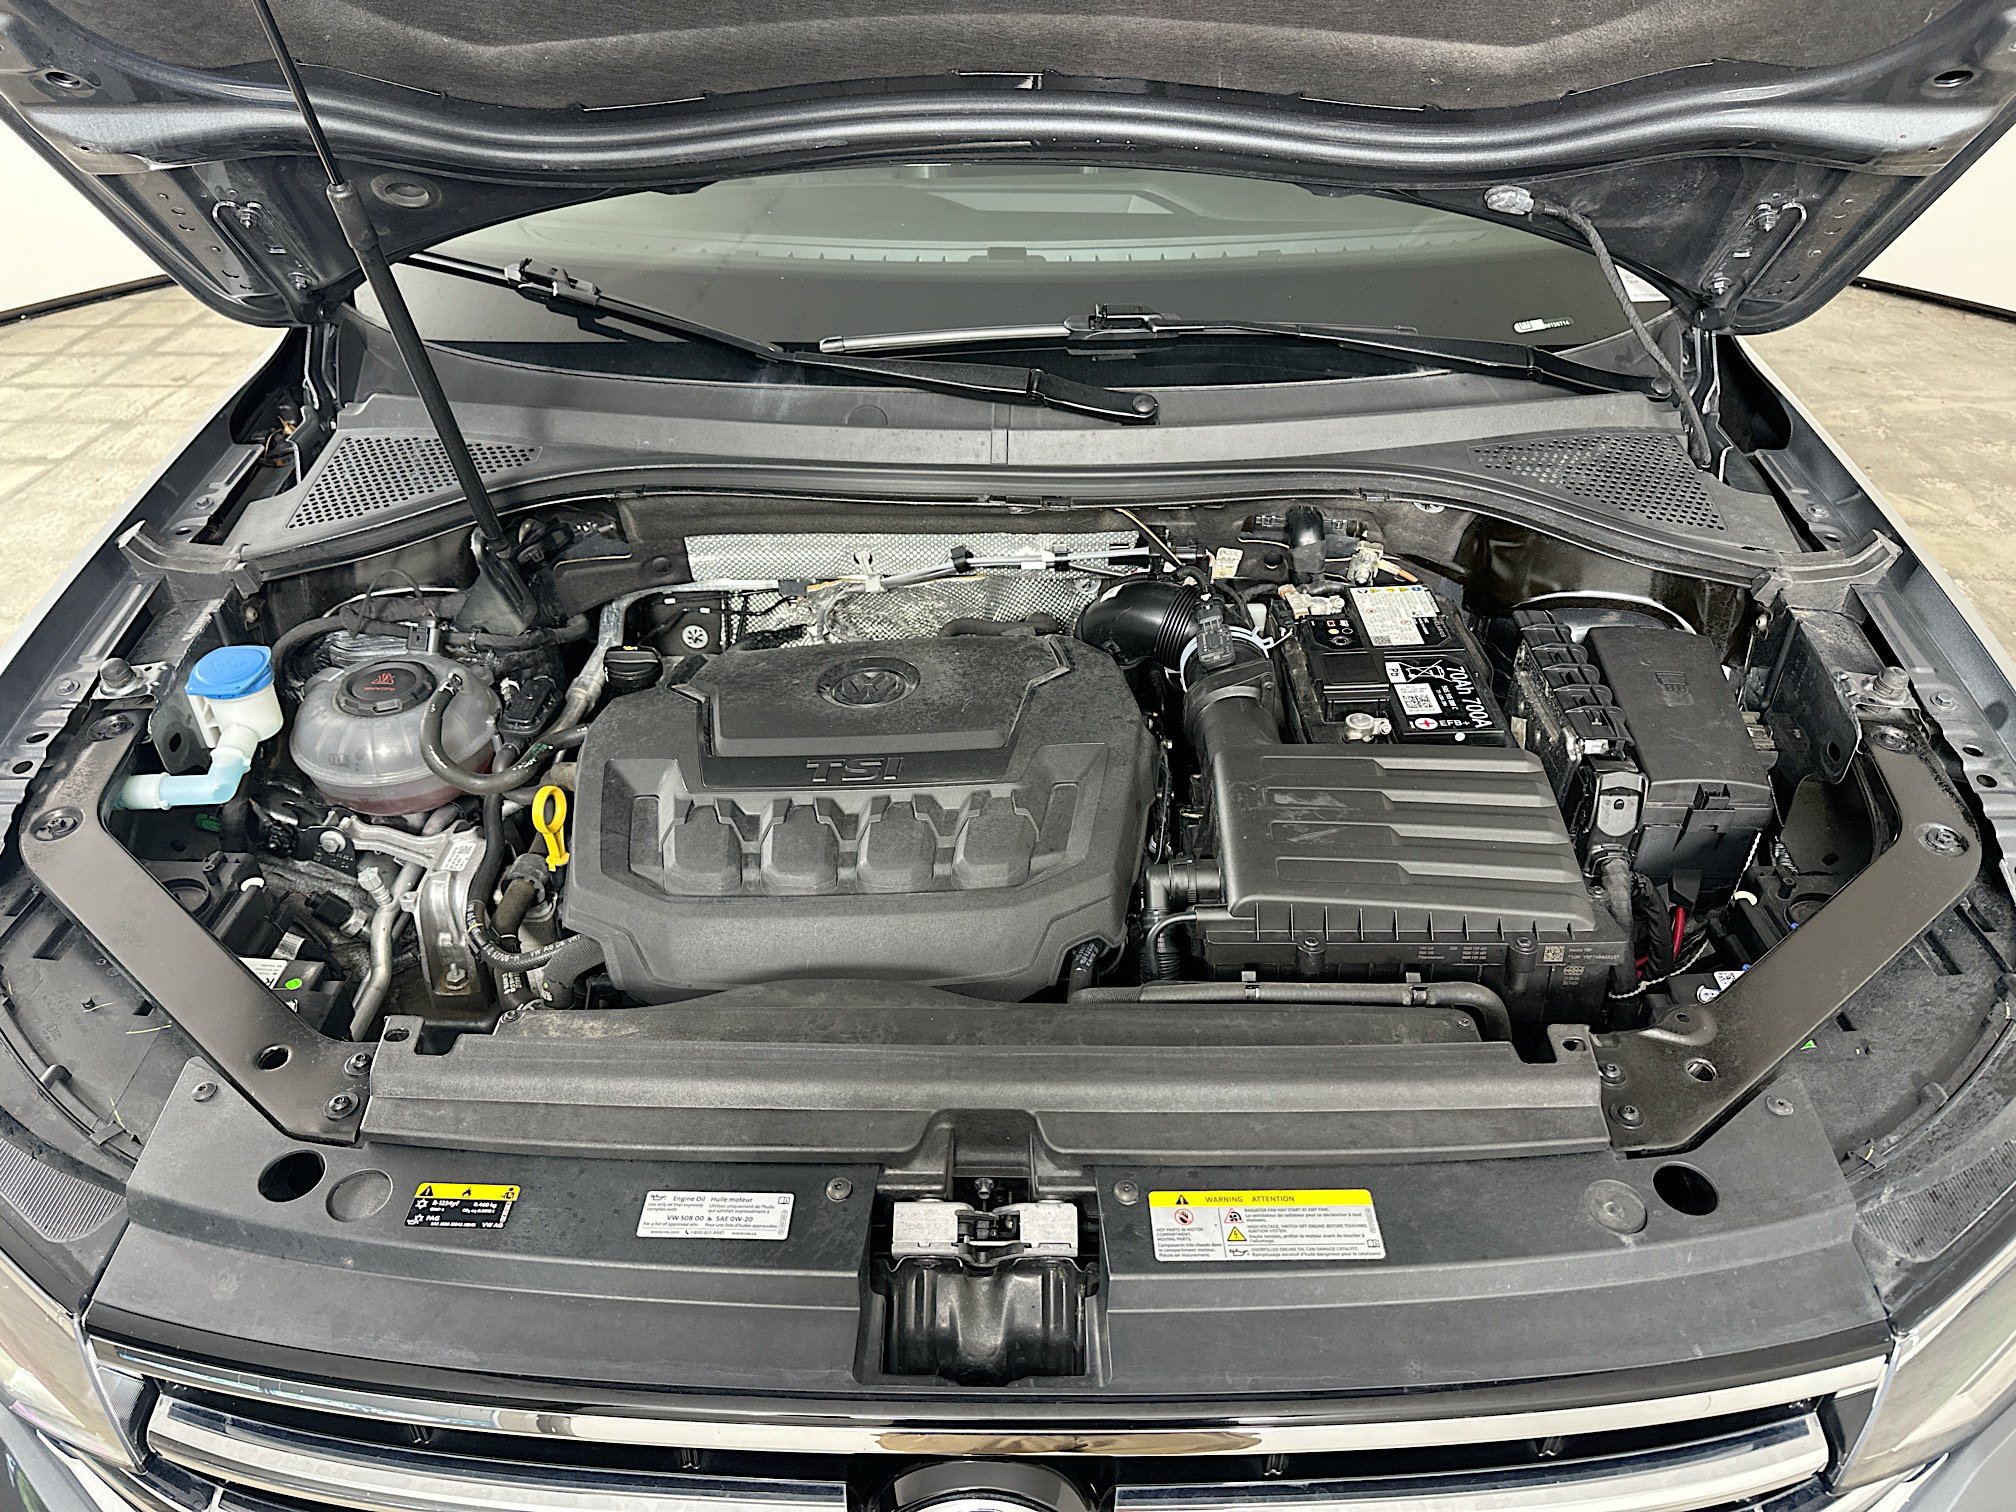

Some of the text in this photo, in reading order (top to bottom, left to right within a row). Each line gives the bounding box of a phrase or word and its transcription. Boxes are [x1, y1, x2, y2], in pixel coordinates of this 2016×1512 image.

[1389, 668, 1399, 677] Pb
[1446, 666, 1474, 695] 70Ah
[1462, 697, 1493, 729] 700A
[1438, 719, 1470, 727] EFB+
[806, 757, 904, 782] TSI
[544, 944, 554, 953] AG
[431, 1199, 461, 1208] R-1234yf
